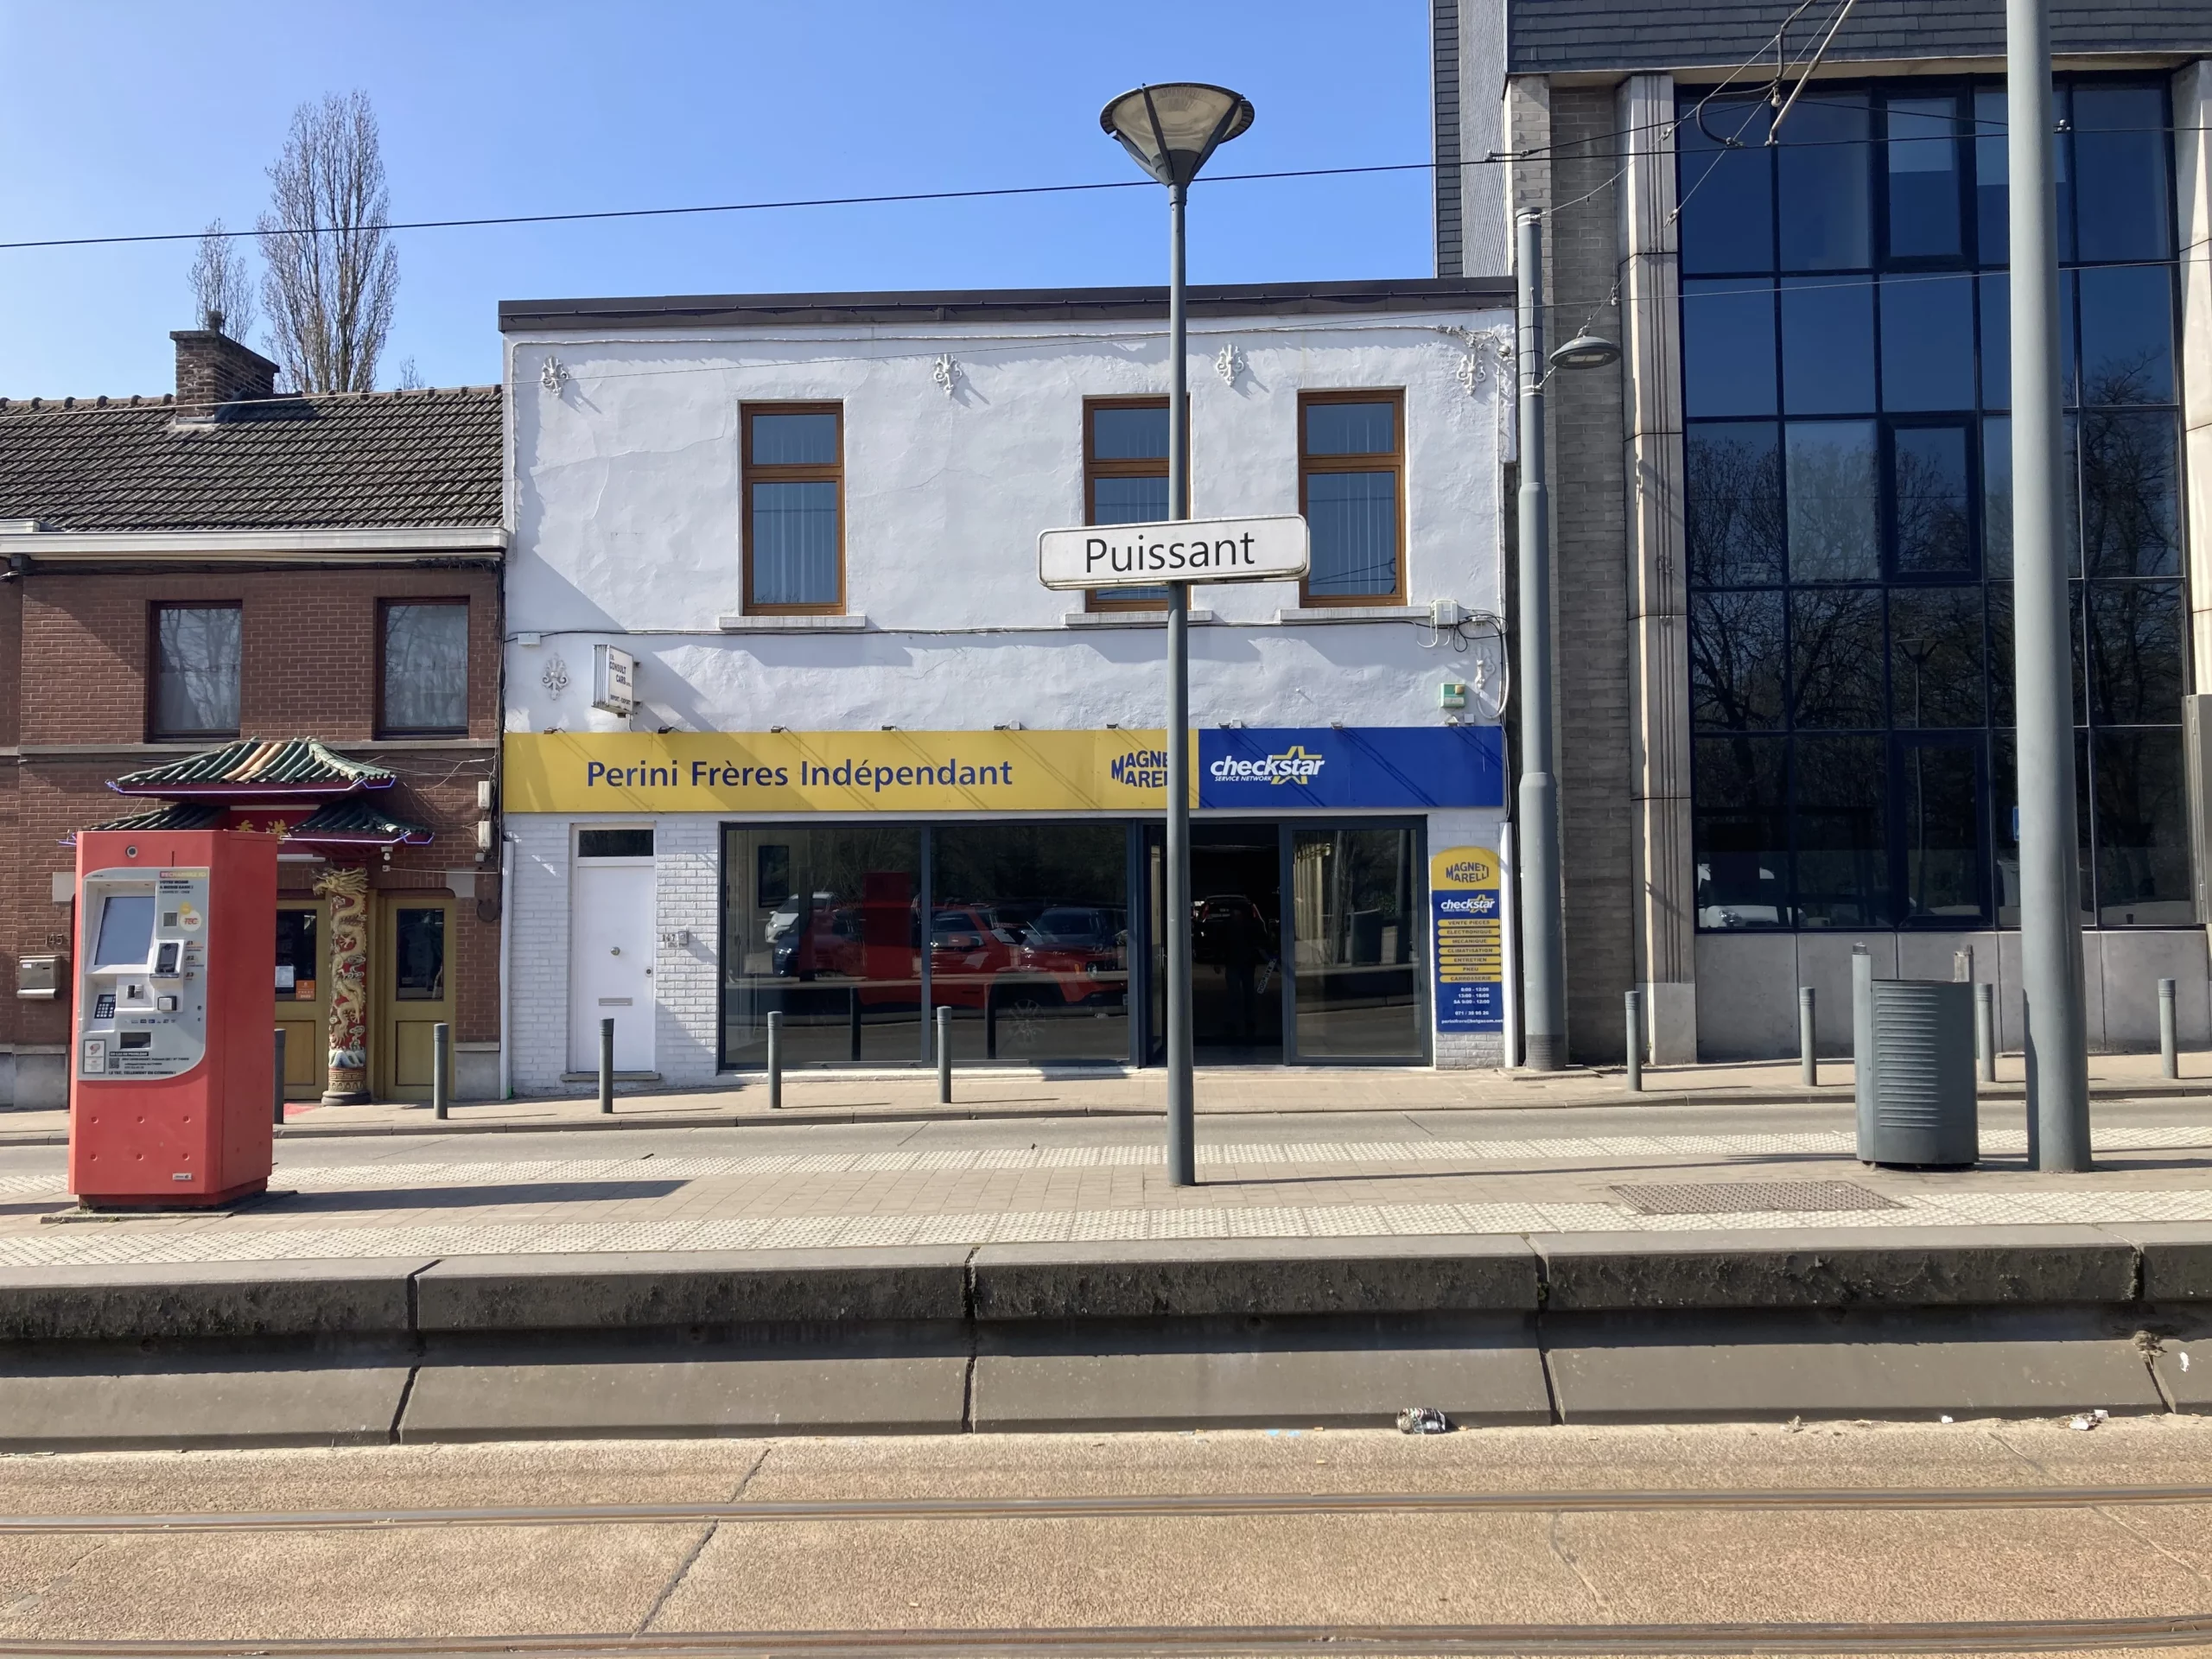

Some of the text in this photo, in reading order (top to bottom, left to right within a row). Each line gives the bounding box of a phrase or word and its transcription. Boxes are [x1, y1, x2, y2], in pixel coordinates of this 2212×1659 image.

[1086, 532, 1255, 573] Puissant
[609, 661, 626, 675] CONSULT
[616, 674, 626, 685] CARS
[1211, 755, 1325, 776] checkstar
[587, 759, 1013, 792] Perini Frères Indépendant
[1446, 861, 1489, 874] MAGNETI
[1446, 868, 1489, 883] MARELLI
[1440, 899, 1495, 910] checkstar
